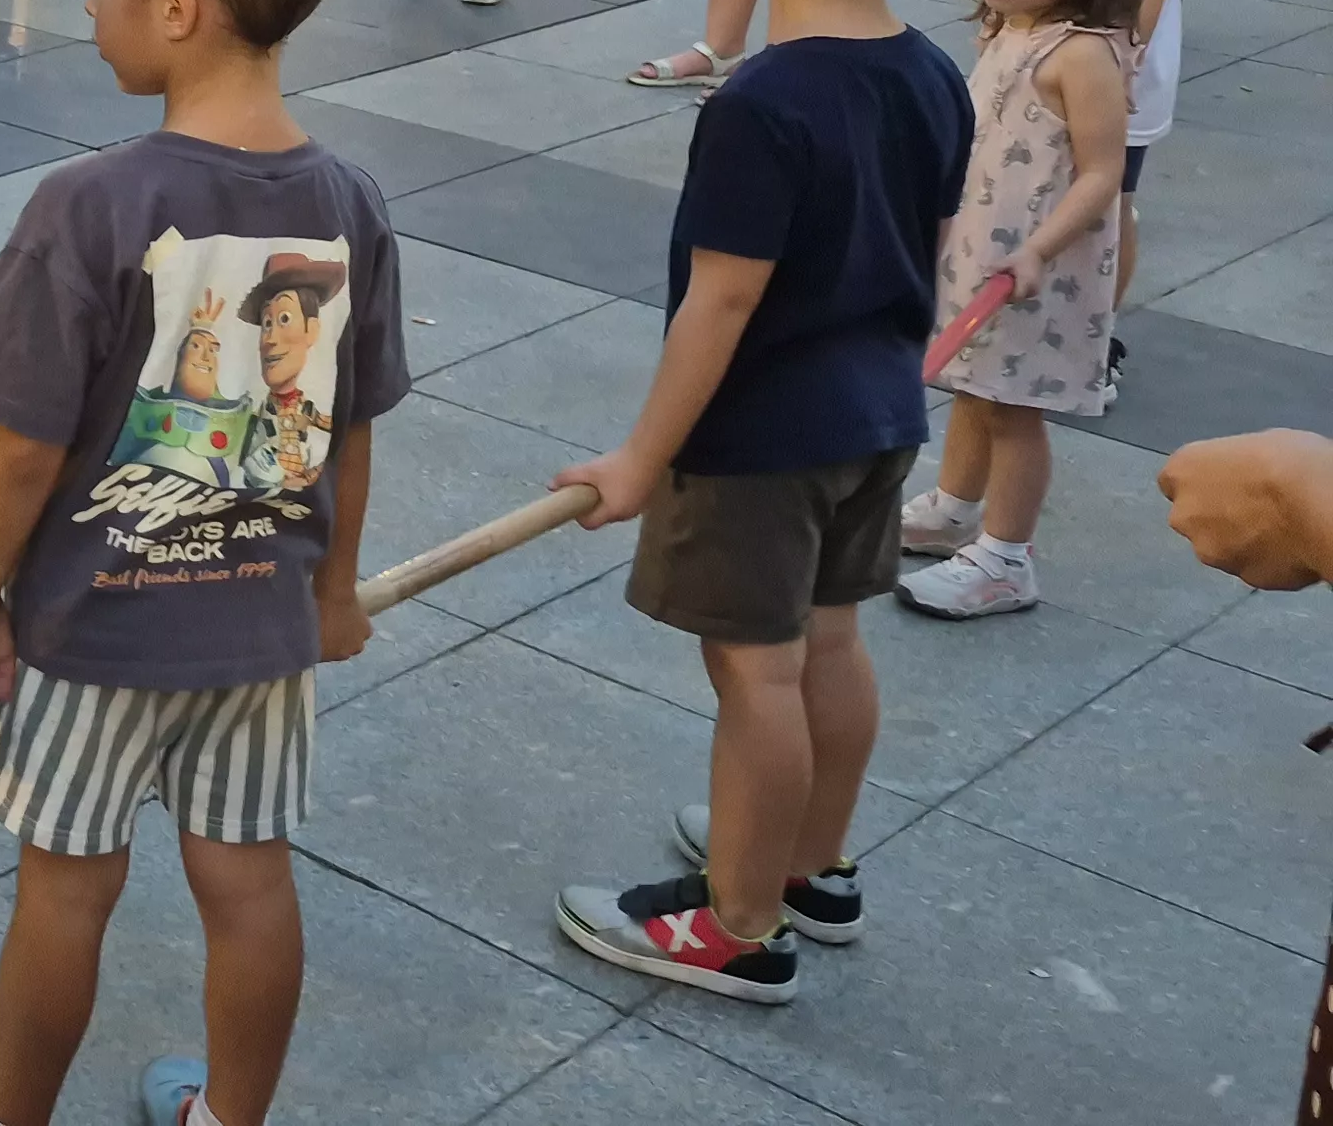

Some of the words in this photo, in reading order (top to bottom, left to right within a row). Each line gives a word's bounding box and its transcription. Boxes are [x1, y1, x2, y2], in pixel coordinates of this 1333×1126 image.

[71, 463, 239, 534] Selfie
[106, 526, 156, 554] THE
[230, 517, 278, 539] ARE
[147, 541, 226, 564] BACK
